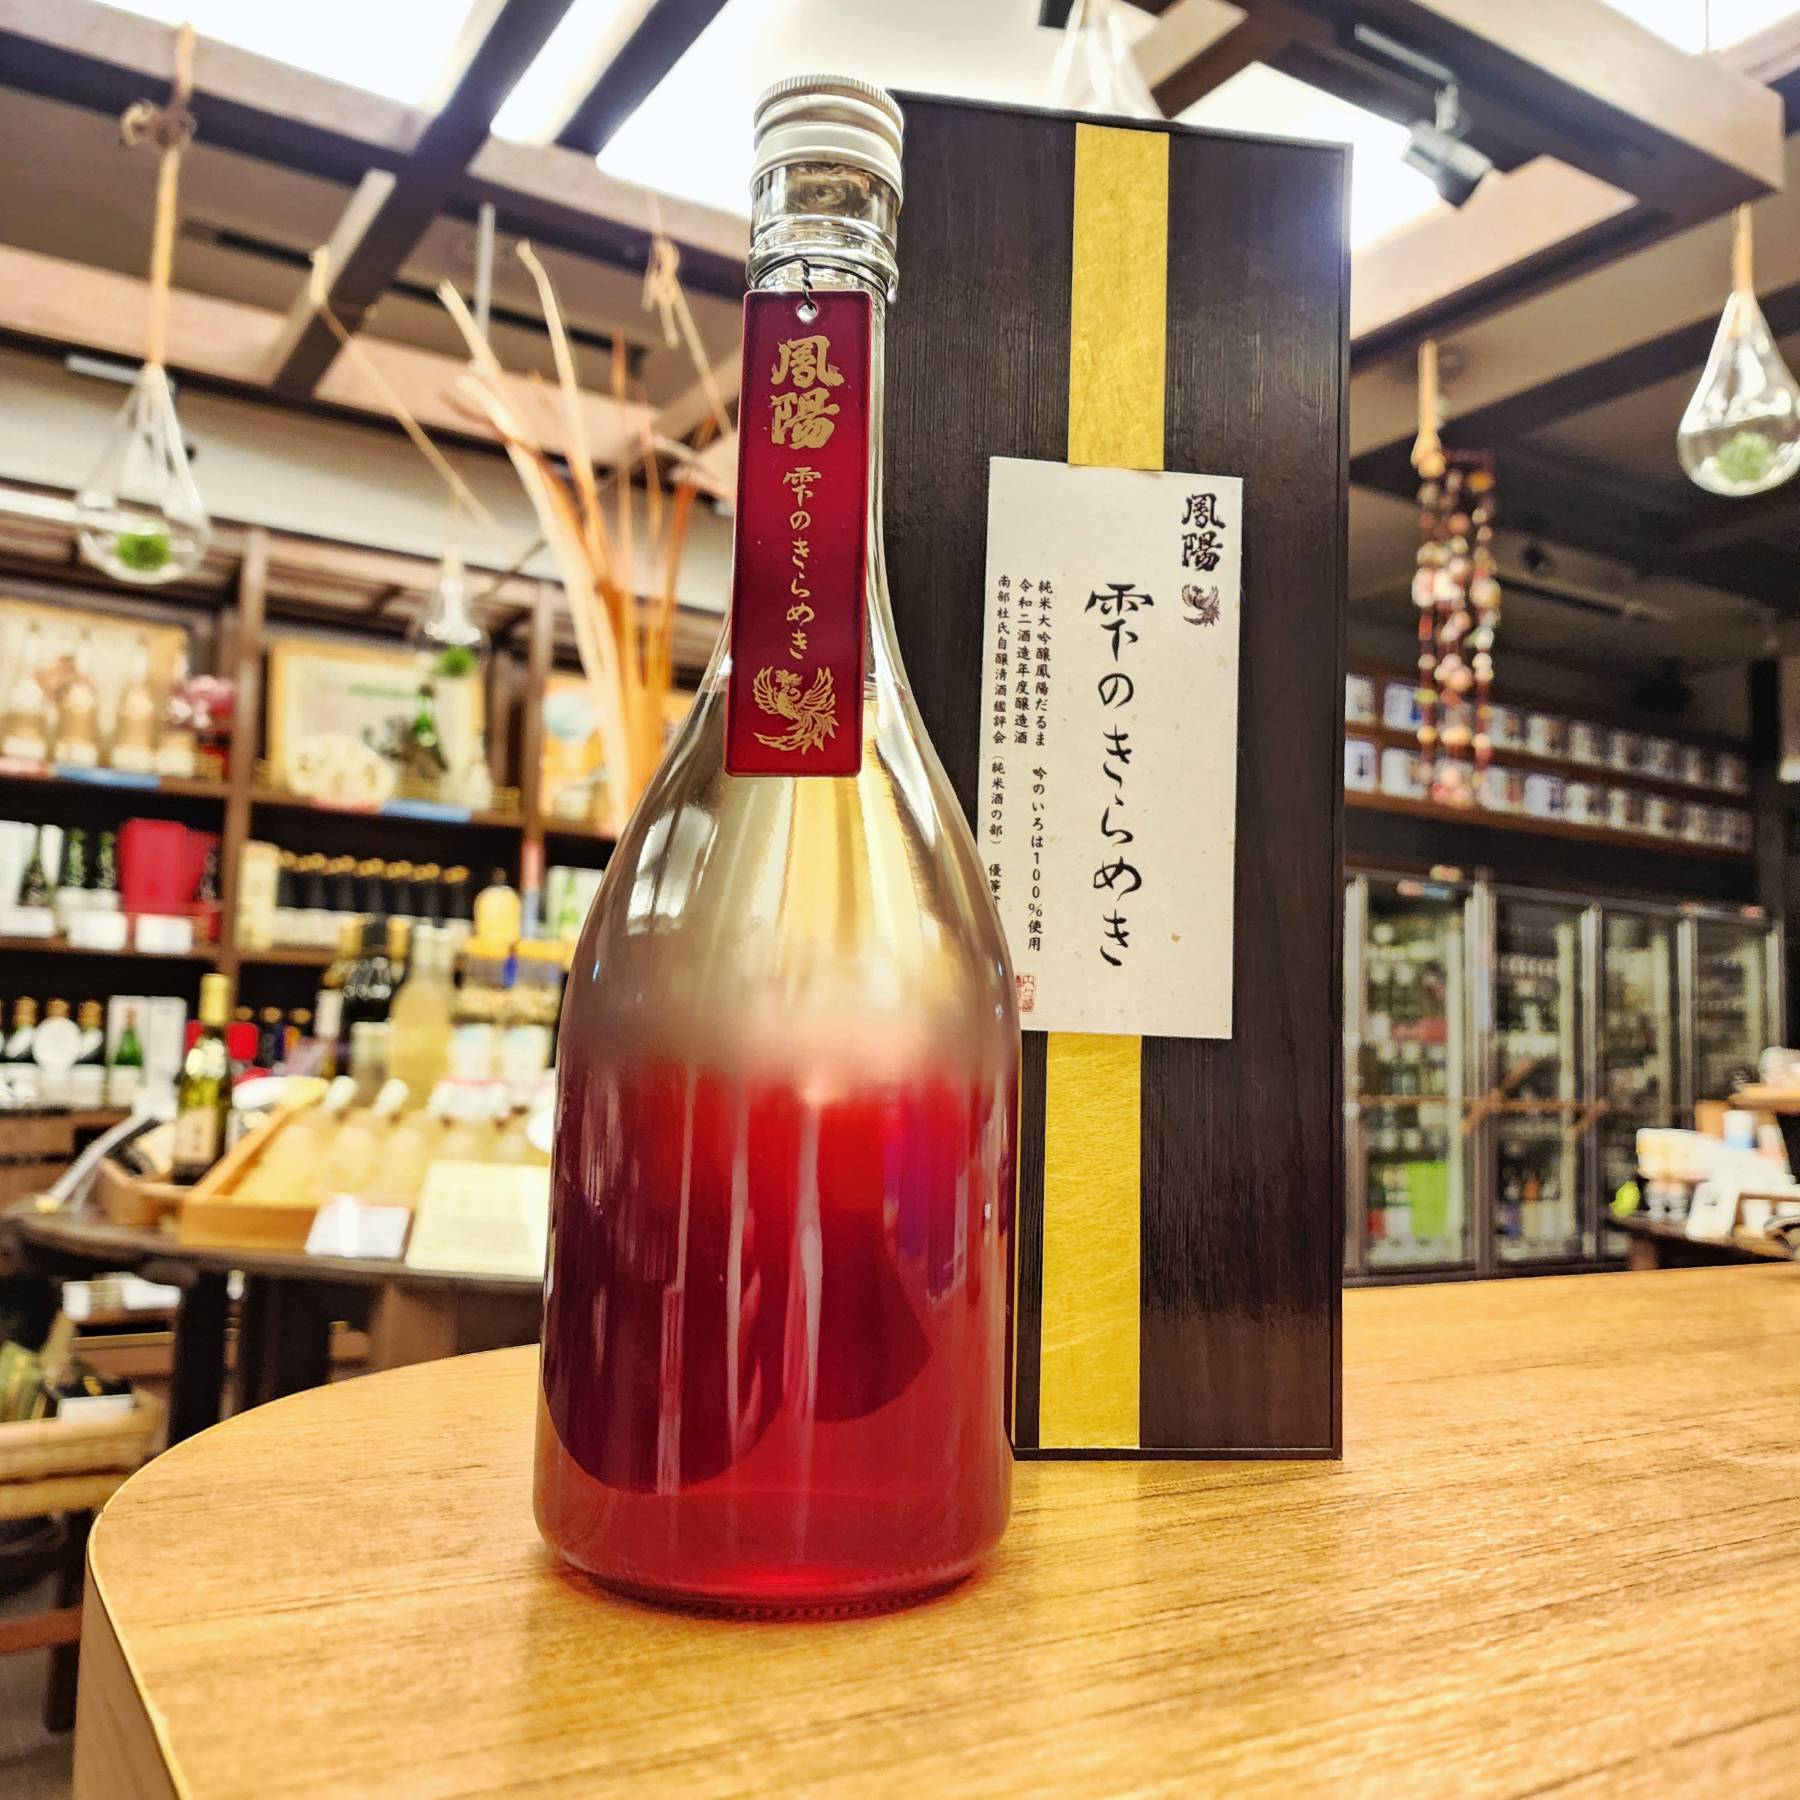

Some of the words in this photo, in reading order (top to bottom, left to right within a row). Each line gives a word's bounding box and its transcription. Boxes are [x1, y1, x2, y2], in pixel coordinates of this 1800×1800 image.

[770, 335, 844, 450] 鳳陽
[782, 466, 822, 661] 雫のきらめき
[1181, 492, 1226, 573] 鳳陽
[992, 574, 1011, 744] 南部杜氏自醸清酒鑑評会
[1014, 578, 1034, 744] 令和二酒造年度醸造酒
[1084, 582, 1155, 967] 雫のきらめき
